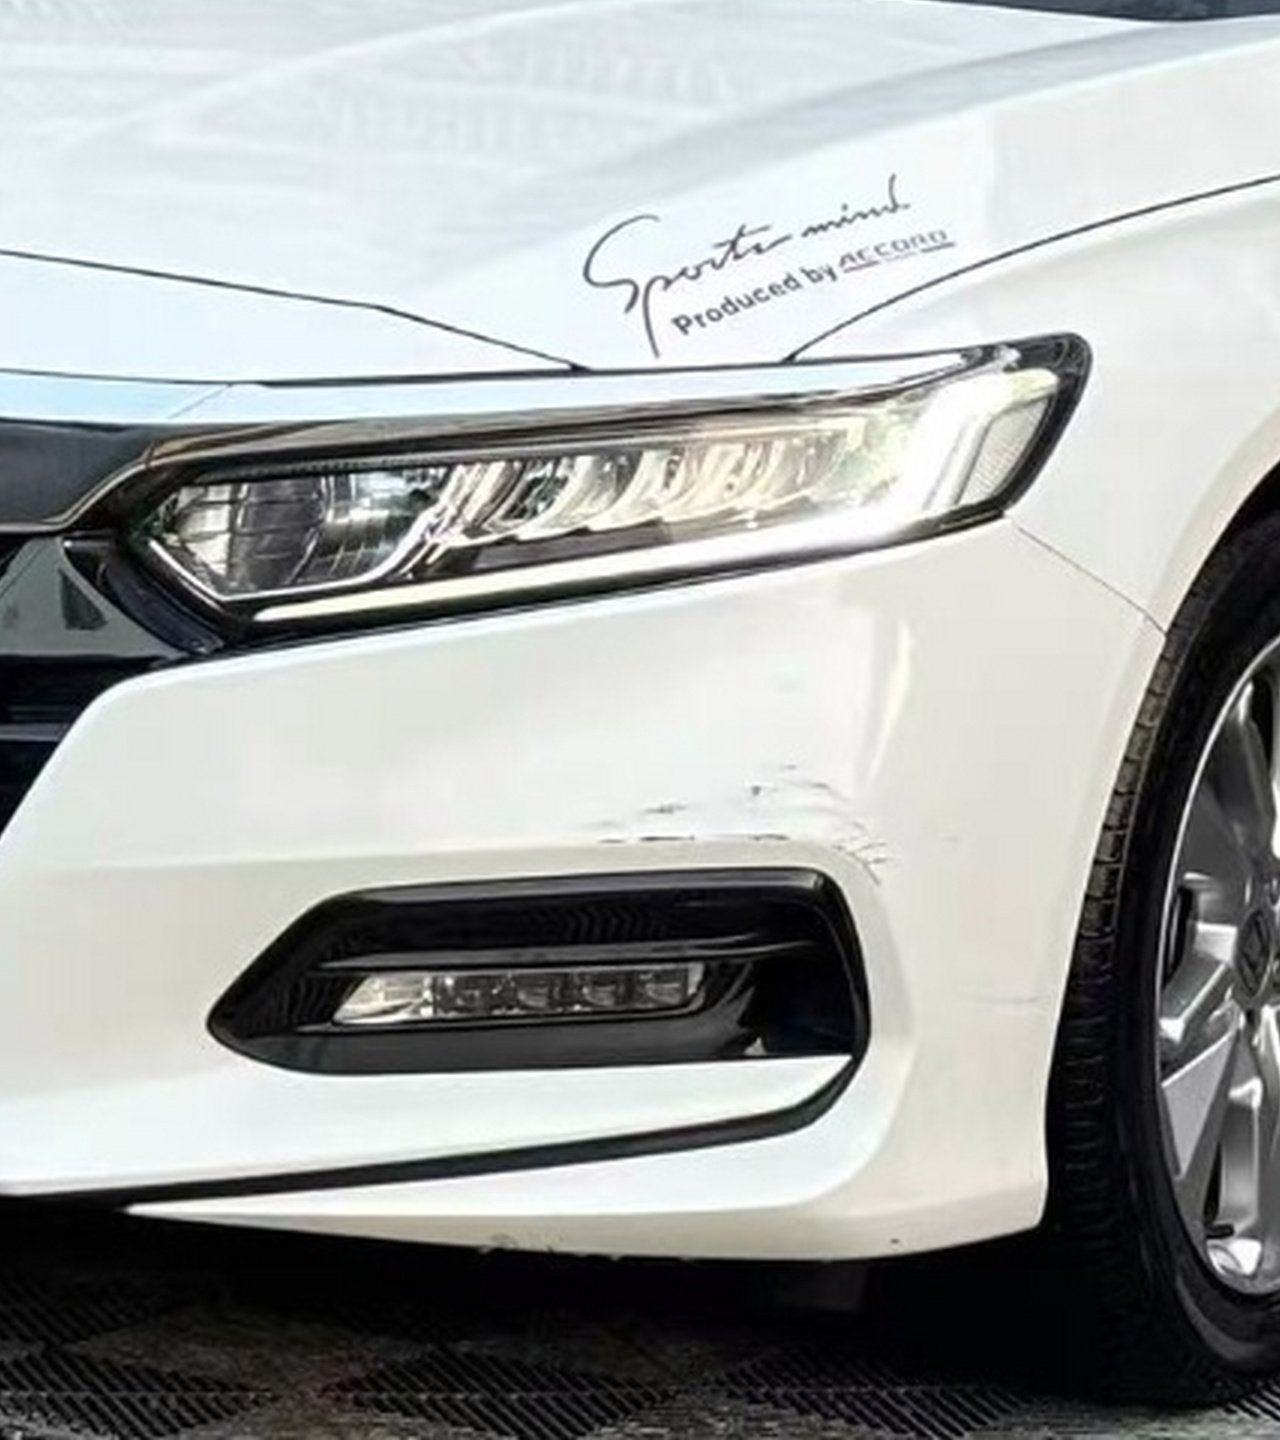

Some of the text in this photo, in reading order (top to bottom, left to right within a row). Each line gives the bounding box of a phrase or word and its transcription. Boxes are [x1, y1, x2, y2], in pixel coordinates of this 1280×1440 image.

[671, 229, 956, 336] Produced by ACCORD
